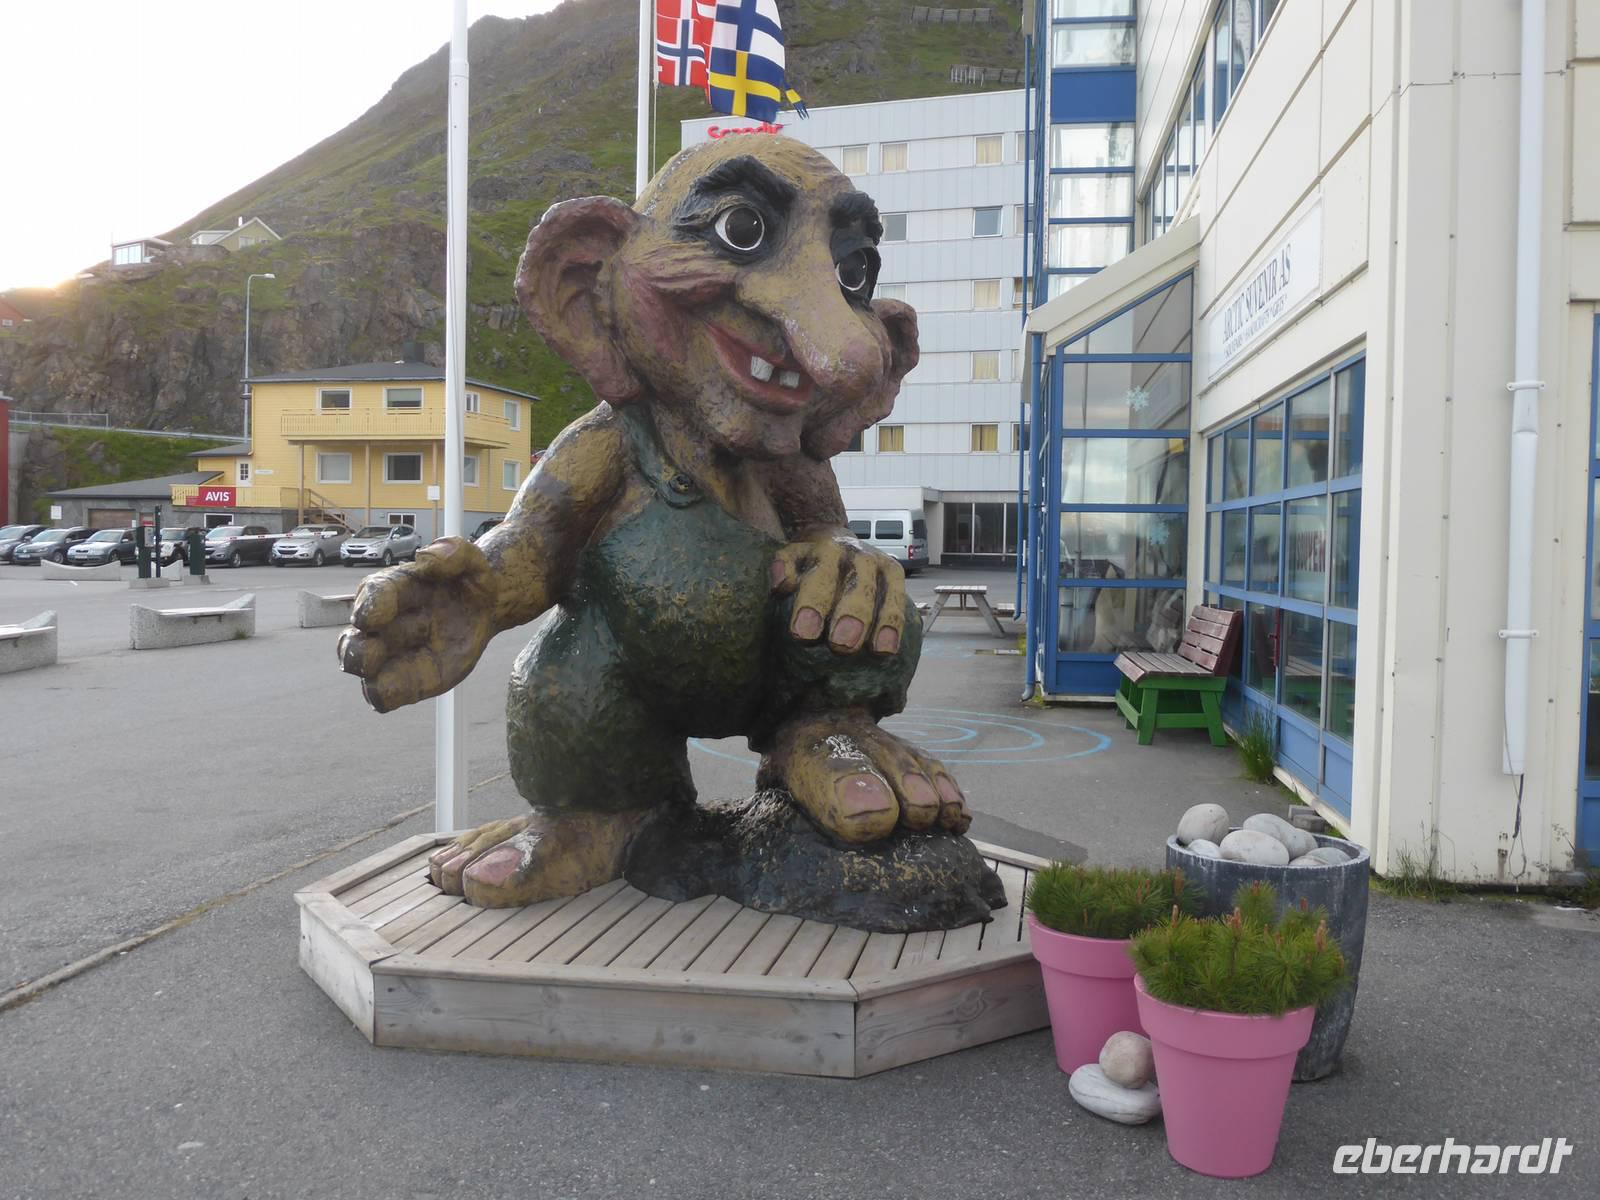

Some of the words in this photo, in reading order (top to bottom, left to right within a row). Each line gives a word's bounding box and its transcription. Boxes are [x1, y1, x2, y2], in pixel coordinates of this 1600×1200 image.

[1223, 292, 1244, 344] ARCTIC
[1279, 243, 1291, 291] AS
[205, 491, 230, 502] AVIS
